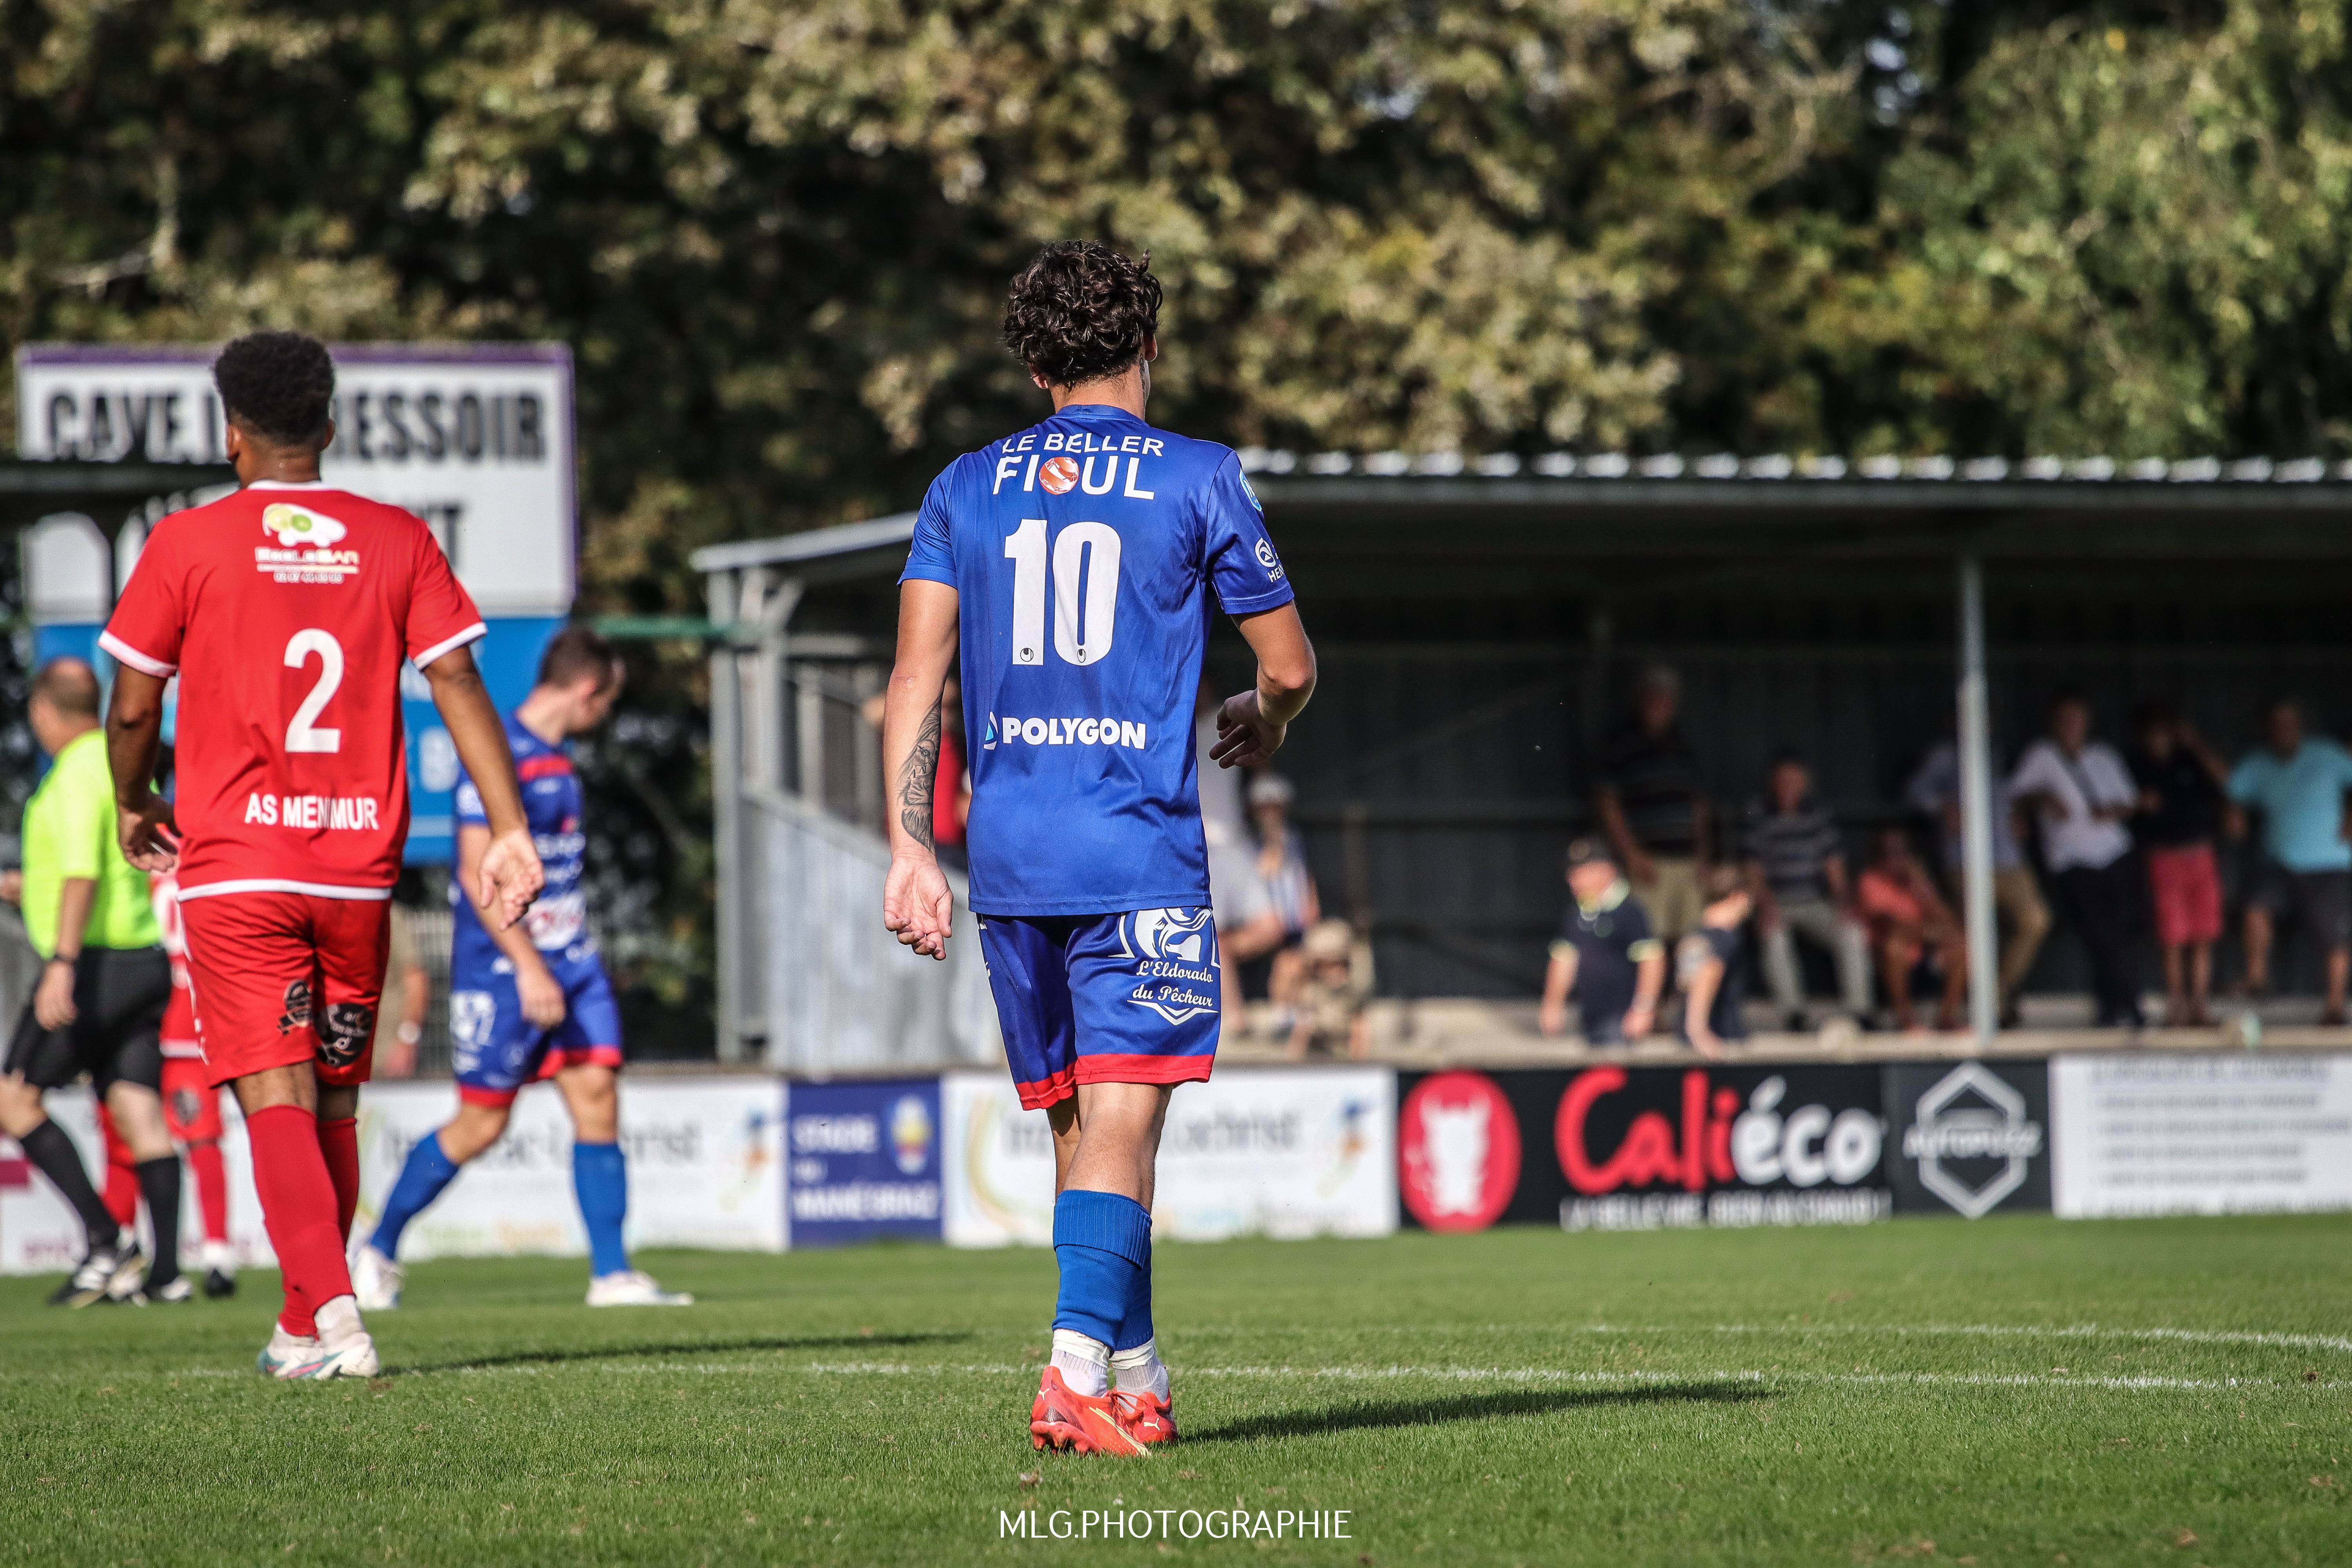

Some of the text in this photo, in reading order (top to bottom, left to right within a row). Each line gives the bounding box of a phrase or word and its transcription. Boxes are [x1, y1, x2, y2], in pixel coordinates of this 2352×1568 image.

[331, 392, 546, 463] RESSOIR
[1002, 433, 1164, 457] LE BELLER
[993, 454, 1154, 500] FIOUL
[1004, 518, 1122, 666] 10
[283, 628, 345, 753] 2
[1002, 717, 1146, 750] POLYGON
[245, 792, 278, 825] AS
[1136, 961, 1213, 983] L'Eldorado
[1132, 984, 1213, 1007] du Pêcheur
[1554, 1063, 1882, 1194] Caliéco
